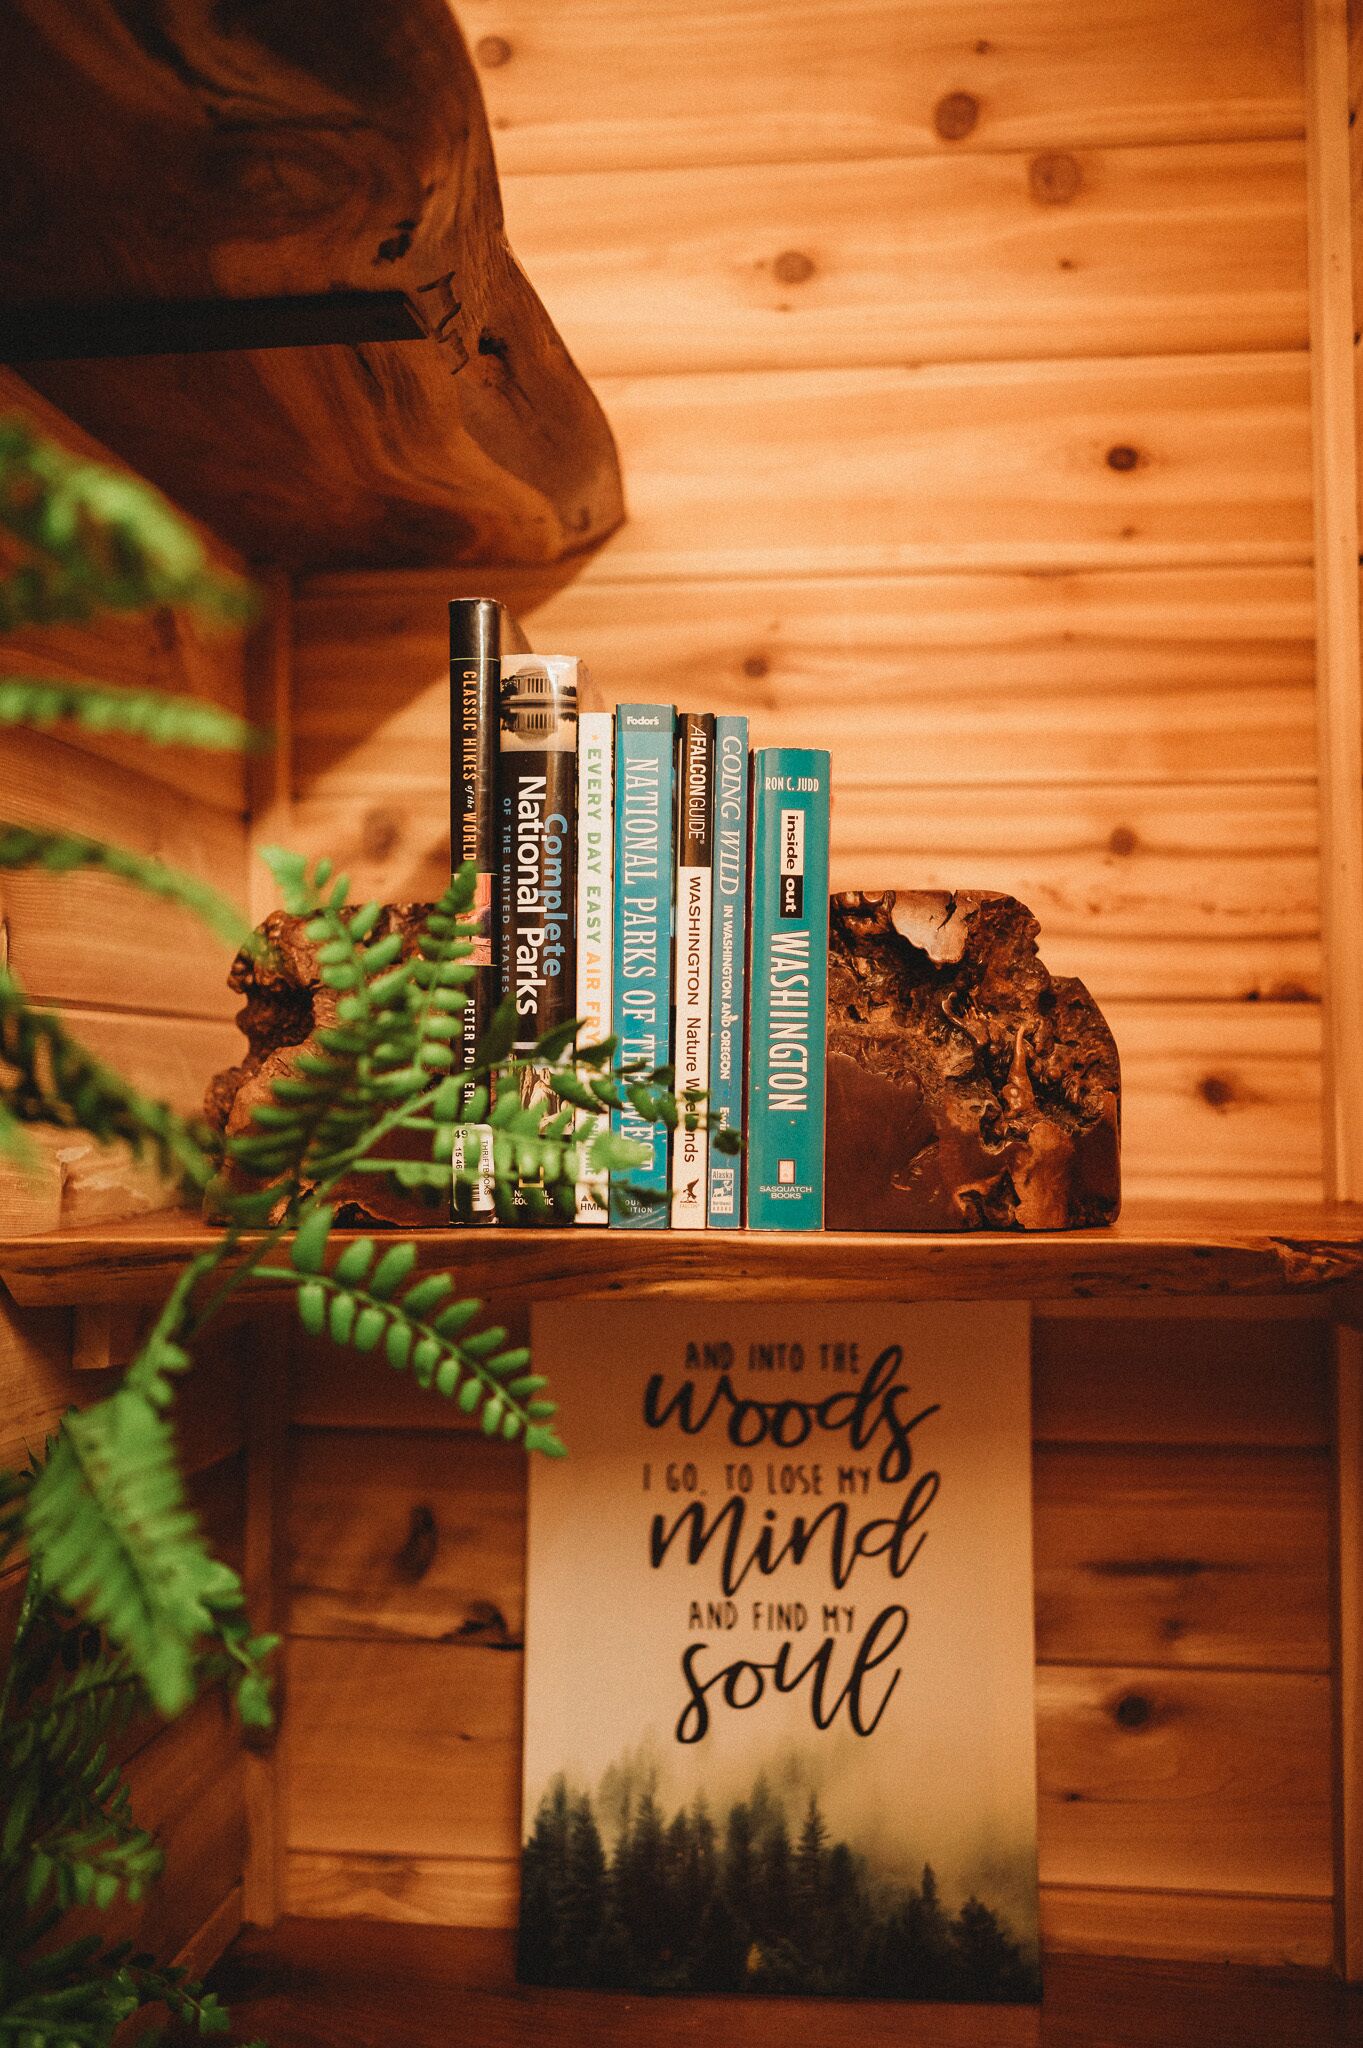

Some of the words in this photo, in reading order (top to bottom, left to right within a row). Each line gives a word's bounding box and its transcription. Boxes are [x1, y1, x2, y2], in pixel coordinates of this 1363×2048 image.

[462, 671, 477, 731] CLASSIC
[626, 716, 659, 726] Fodor's
[462, 738, 478, 780] HIKES
[720, 735, 742, 820] GOING
[765, 777, 784, 790] RON
[786, 777, 795, 791] C.
[797, 777, 819, 791] JUDD
[464, 785, 475, 796] of
[467, 796, 475, 809] the
[503, 798, 512, 815] OF
[586, 748, 601, 821] EVERY
[462, 812, 477, 861] WORLD
[503, 825, 512, 854] THE
[516, 776, 547, 913] National
[624, 757, 659, 885] NATIONAL
[786, 815, 799, 870] inside
[586, 832, 601, 875] DAY
[719, 829, 740, 896] WILD
[502, 864, 511, 924] UNITED
[542, 813, 568, 977] Complete
[586, 885, 601, 943] EASY
[724, 905, 733, 918] IN
[785, 877, 796, 913] out
[623, 896, 657, 978] PARKS
[687, 876, 701, 1006] WASHINGTON
[721, 920, 733, 999] WASHINGTON
[502, 934, 510, 993] STATES
[516, 927, 546, 1015] Parks
[586, 952, 601, 990] AIR
[464, 999, 476, 1041] PETER
[622, 989, 656, 1023] OF
[720, 1001, 732, 1027] AND
[768, 930, 810, 1111] WASHINGTON
[622, 1034, 655, 1085] THE
[686, 1018, 701, 1072] Nature
[720, 1032, 731, 1080] OREGON
[481, 1139, 491, 1196] THRIFTBOOKS
[712, 1170, 733, 1179] Alaska
[759, 1185, 813, 1194] SASQUATCH
[770, 1192, 802, 1200] BOOKS
[685, 1341, 734, 1371] AND
[748, 1343, 804, 1373] INTO
[820, 1343, 860, 1375] THE
[643, 1344, 941, 1484] woods
[642, 1463, 652, 1491] I
[725, 1463, 753, 1493] TO
[767, 1463, 824, 1495] LOSE
[837, 1465, 872, 1496] MY
[649, 1470, 941, 1598] mind
[688, 1602, 738, 1631] AND
[752, 1602, 808, 1632] FIND
[822, 1604, 856, 1633] MY
[675, 1604, 909, 1744] soul
